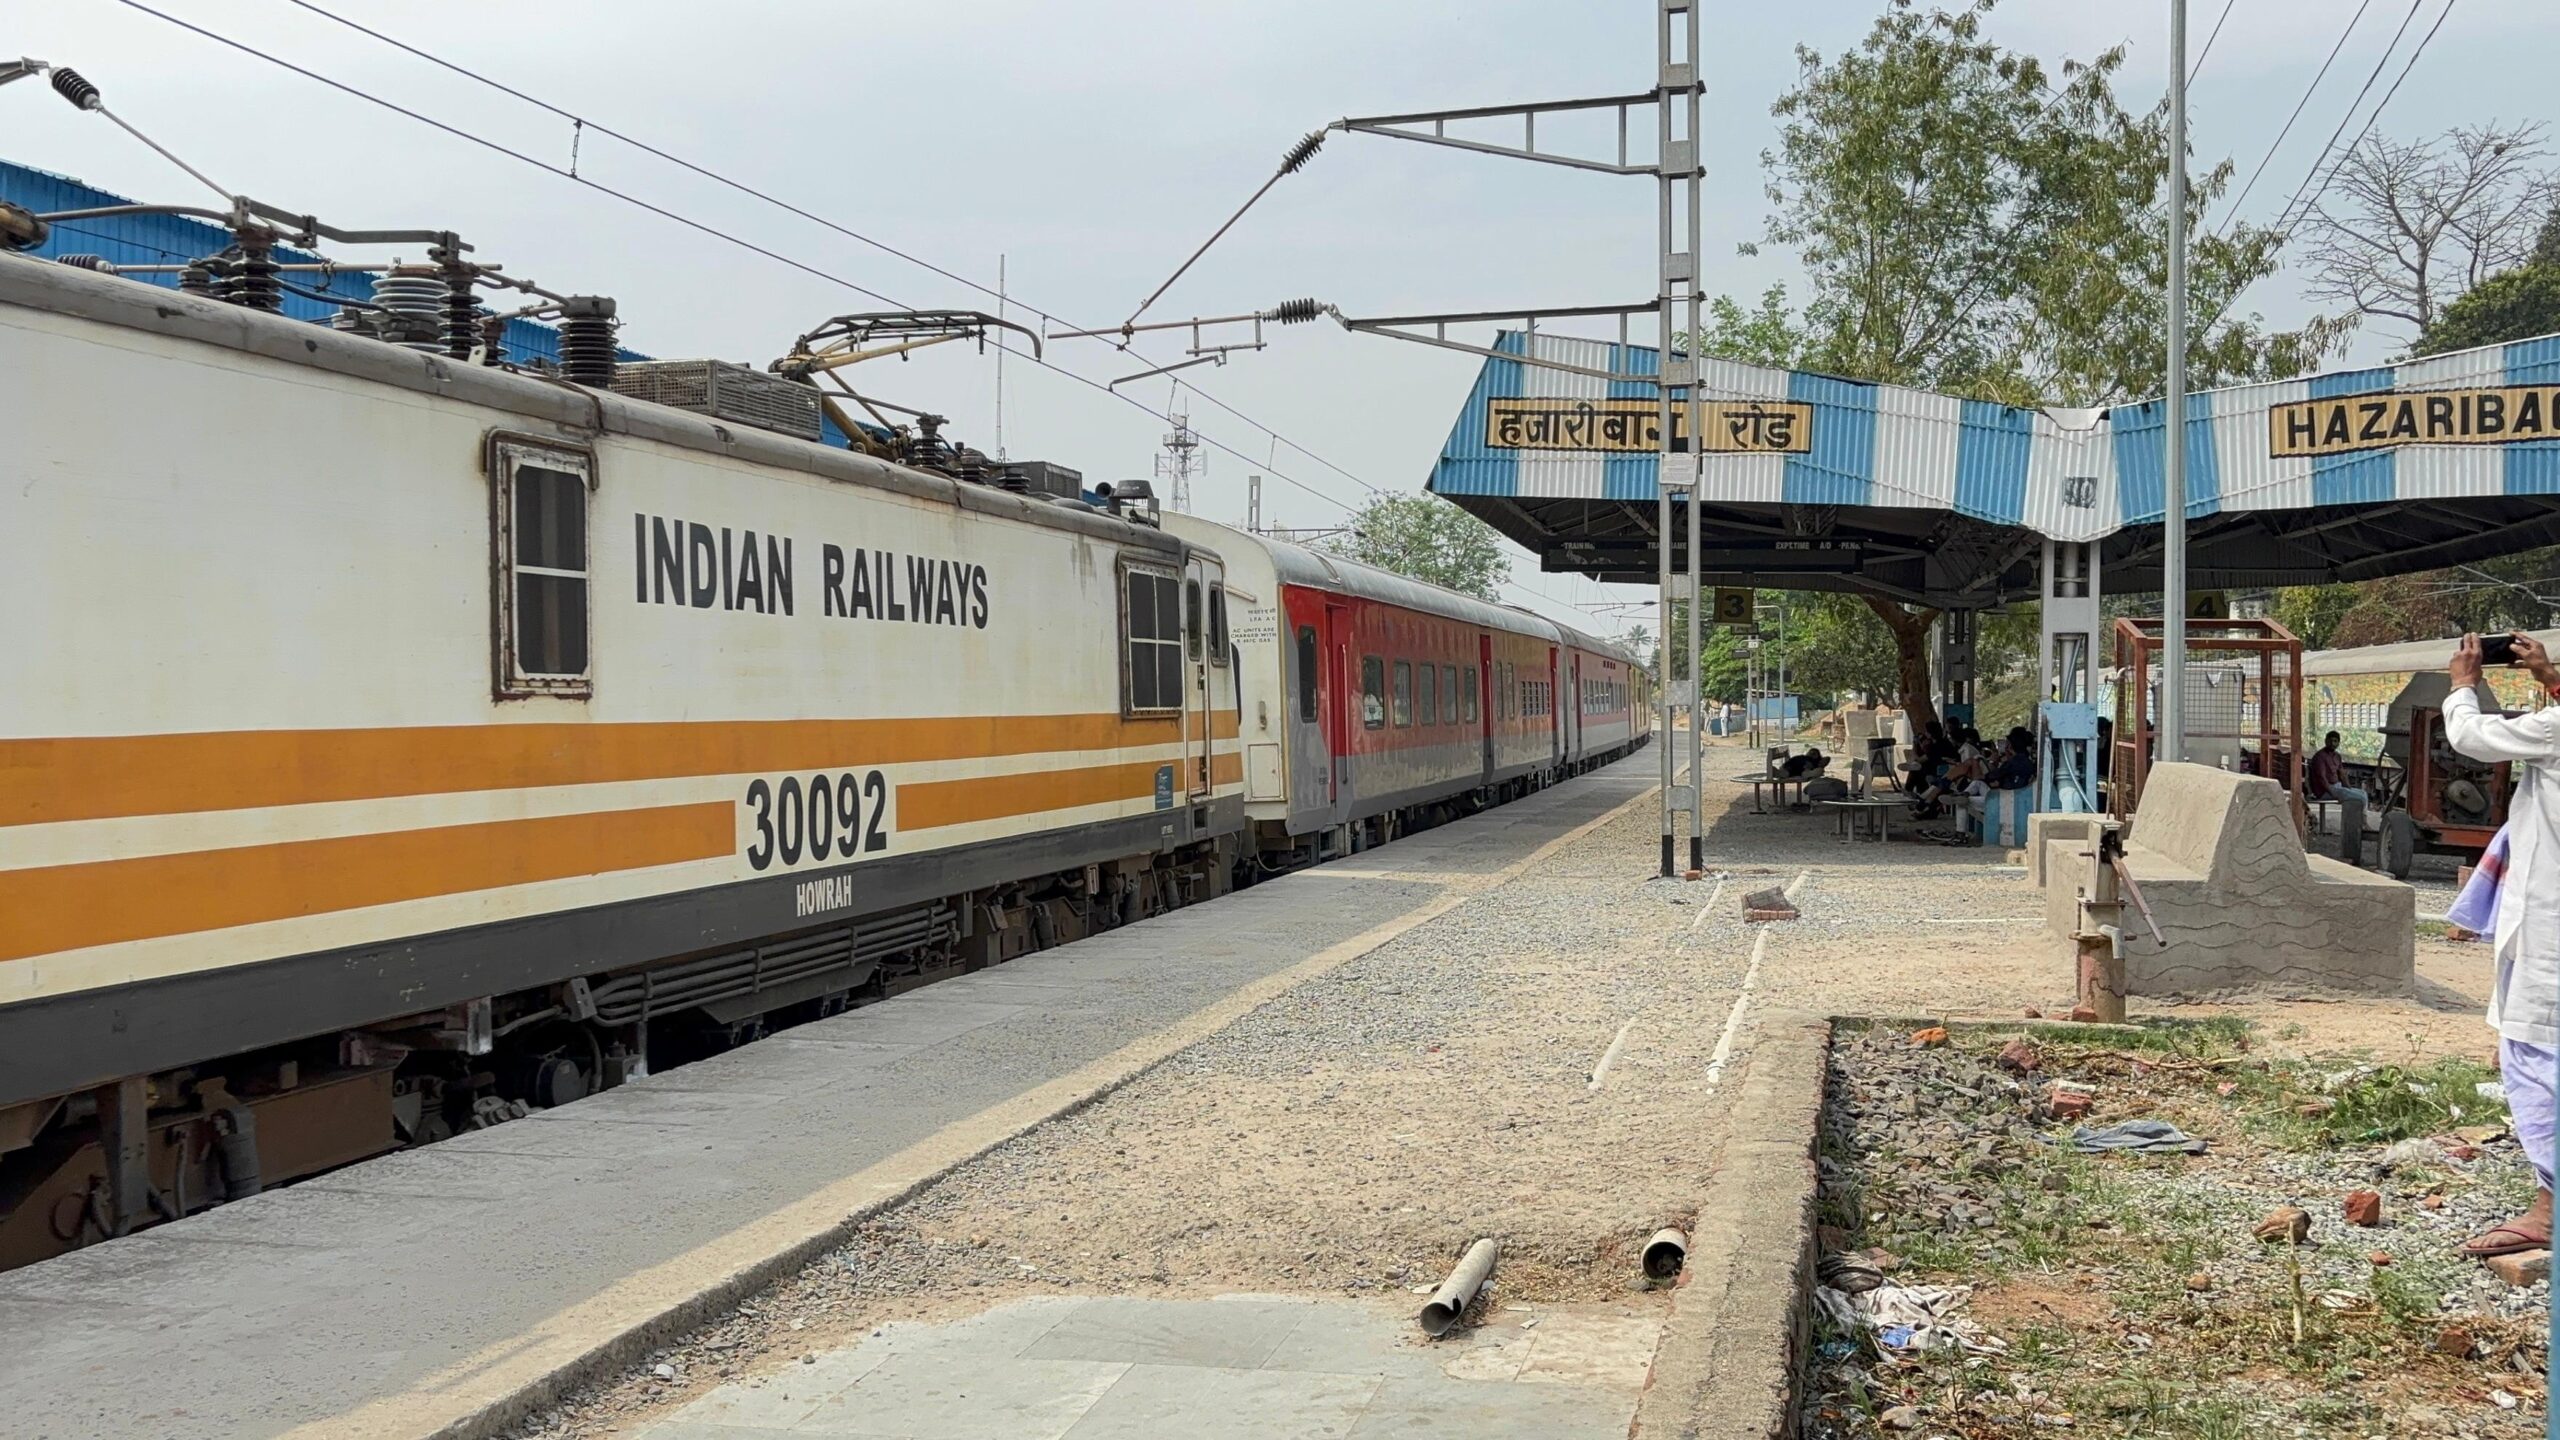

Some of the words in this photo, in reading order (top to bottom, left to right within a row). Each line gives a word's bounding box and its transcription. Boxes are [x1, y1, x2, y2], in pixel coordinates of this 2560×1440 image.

[1723, 404, 1796, 448] रोड
[635, 513, 794, 616] INDIAN
[823, 543, 989, 630] RAILWAYS
[1724, 594, 1745, 618] 3
[2194, 596, 2217, 617] 4
[746, 769, 887, 871] 30092
[796, 874, 852, 918] HOWRAH
